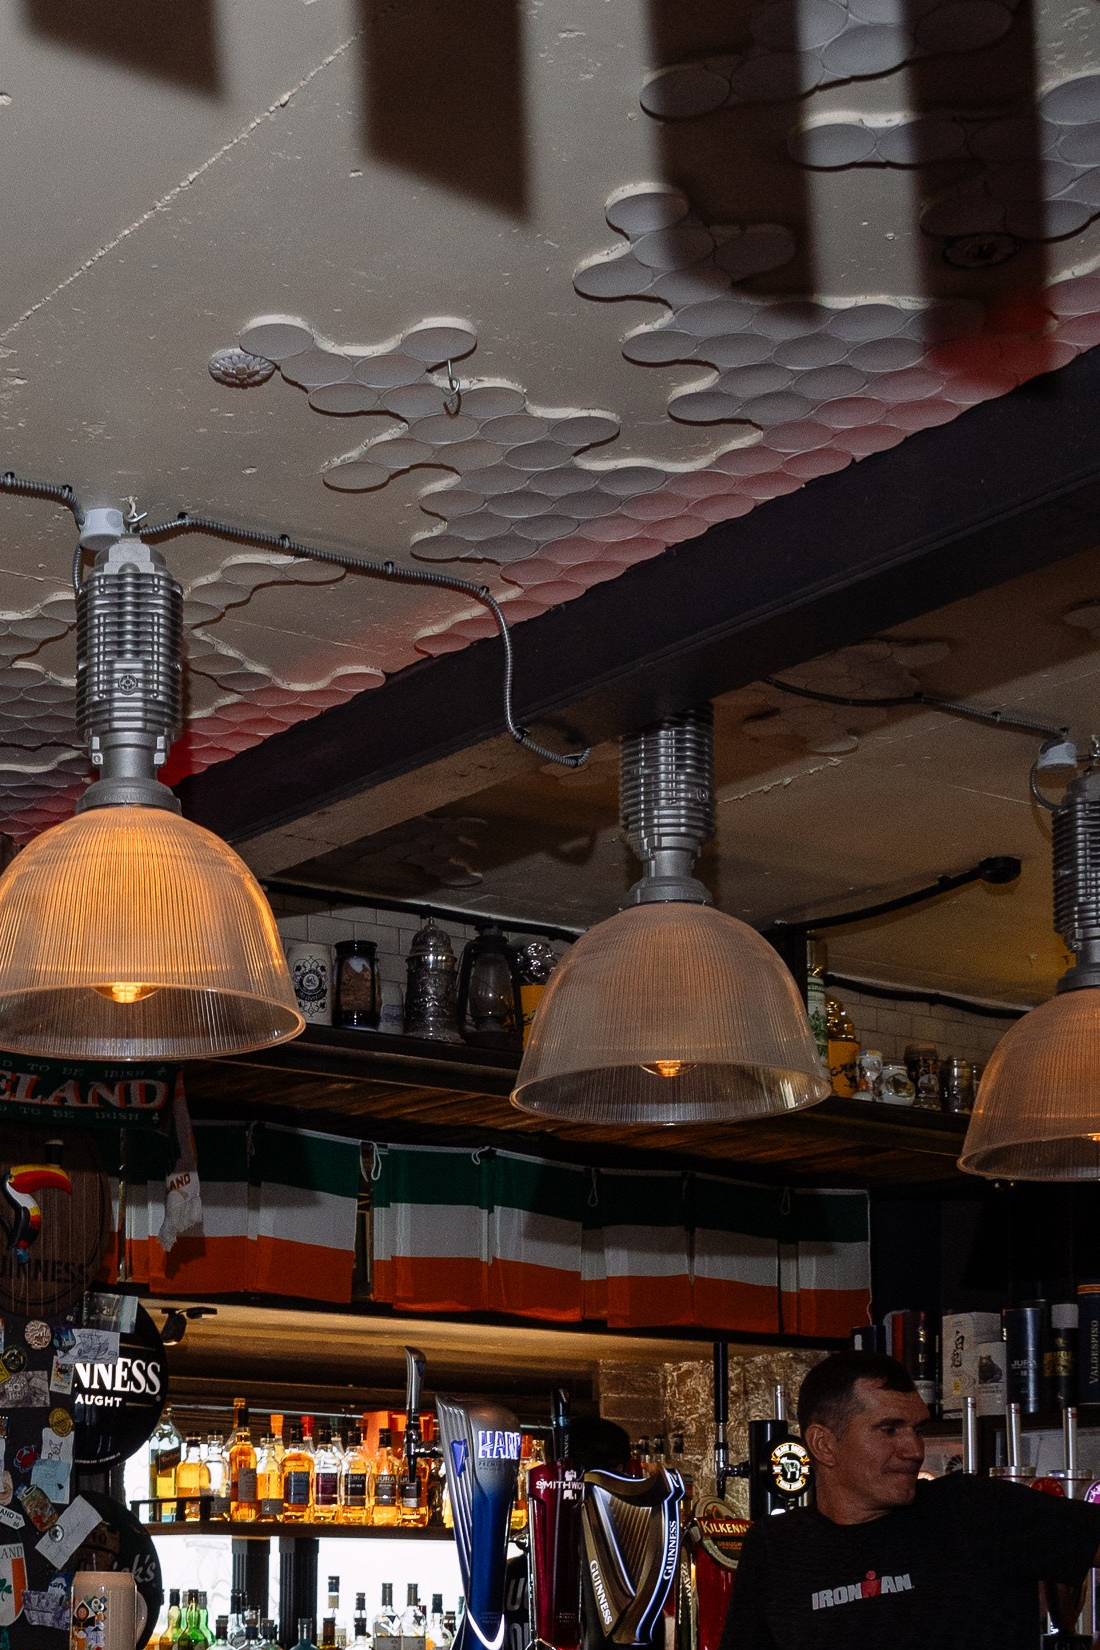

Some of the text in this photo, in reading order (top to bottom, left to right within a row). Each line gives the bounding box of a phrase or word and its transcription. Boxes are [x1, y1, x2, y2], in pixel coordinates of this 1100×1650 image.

[27, 1062, 50, 1072] TO
[62, 1067, 84, 1077] BE
[104, 1069, 146, 1079] IRISH
[19, 1106, 42, 1116] TO
[52, 1110, 75, 1119] BE
[95, 1112, 140, 1121] IRISH
[74, 1393, 123, 1408] AUGHT
[478, 1430, 521, 1460] HARP
[701, 1521, 749, 1534] KILKENN
[662, 1521, 677, 1580] GUINNESS
[590, 1560, 612, 1625] GUINNESS
